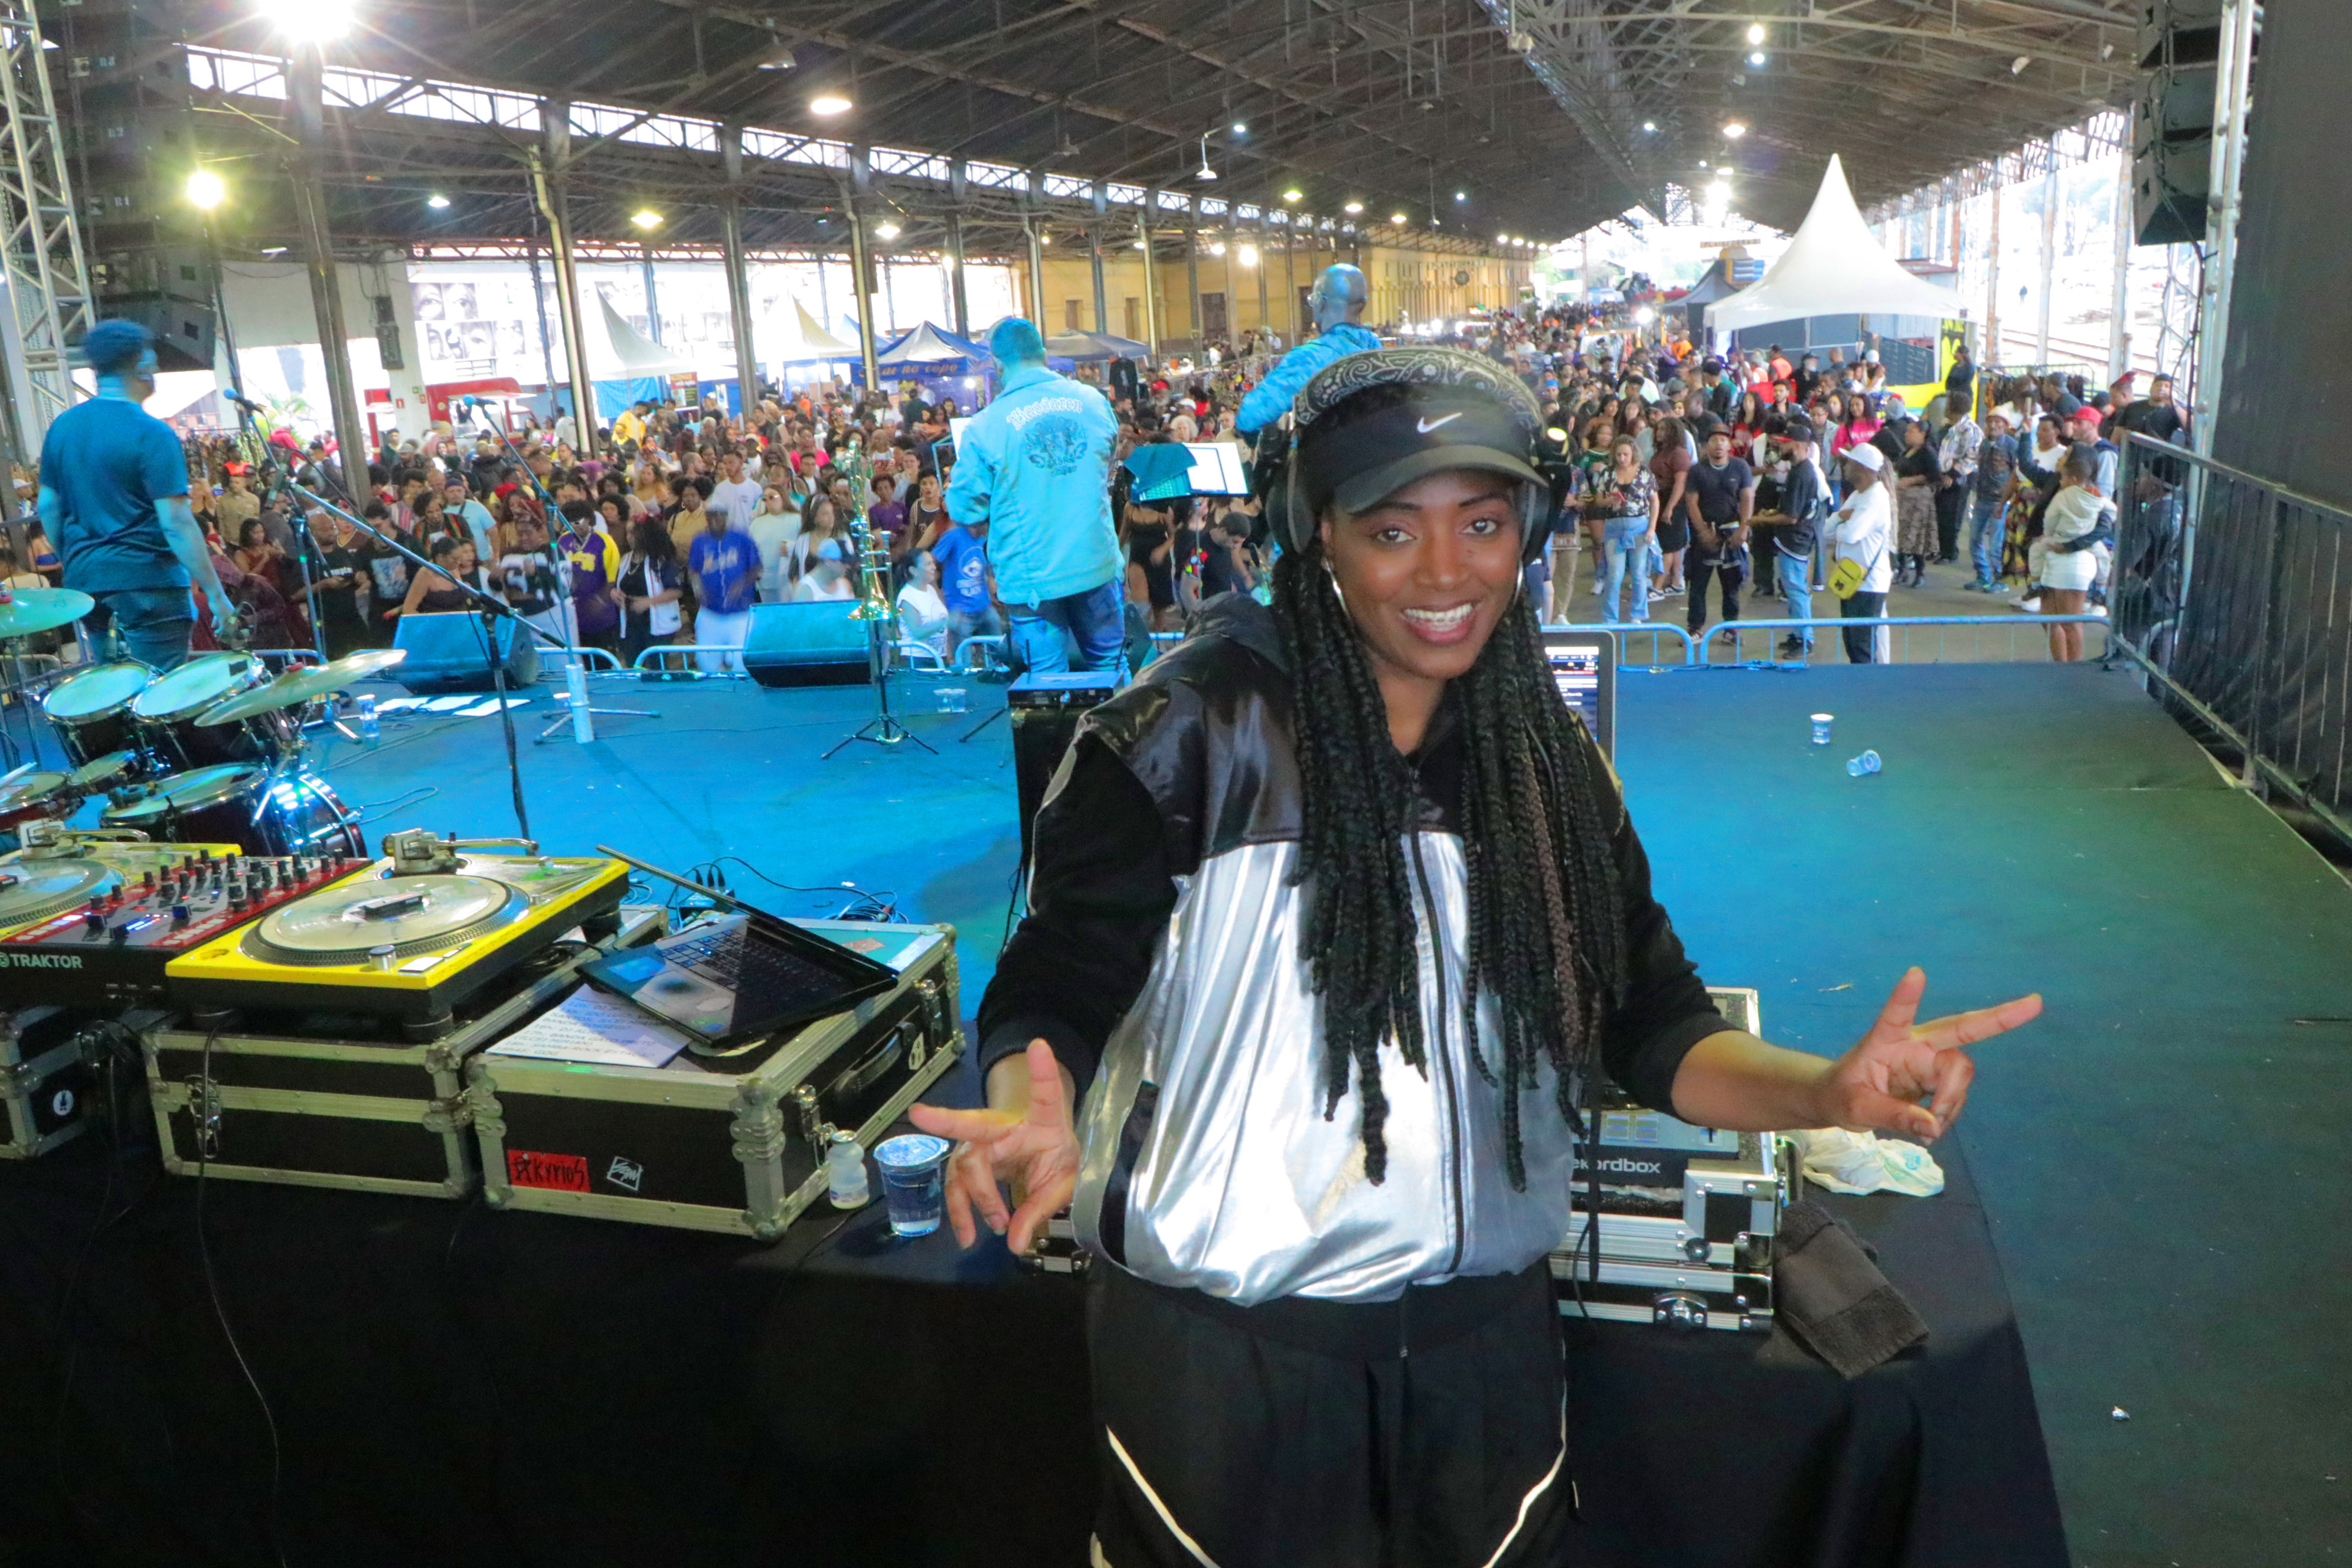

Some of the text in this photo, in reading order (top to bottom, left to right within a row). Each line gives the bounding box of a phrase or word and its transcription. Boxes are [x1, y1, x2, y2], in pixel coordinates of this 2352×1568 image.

[115, 195, 129, 207] R1
[9, 954, 83, 968] TRAKTOR
[1573, 1158, 1661, 1174] ekrdbox
